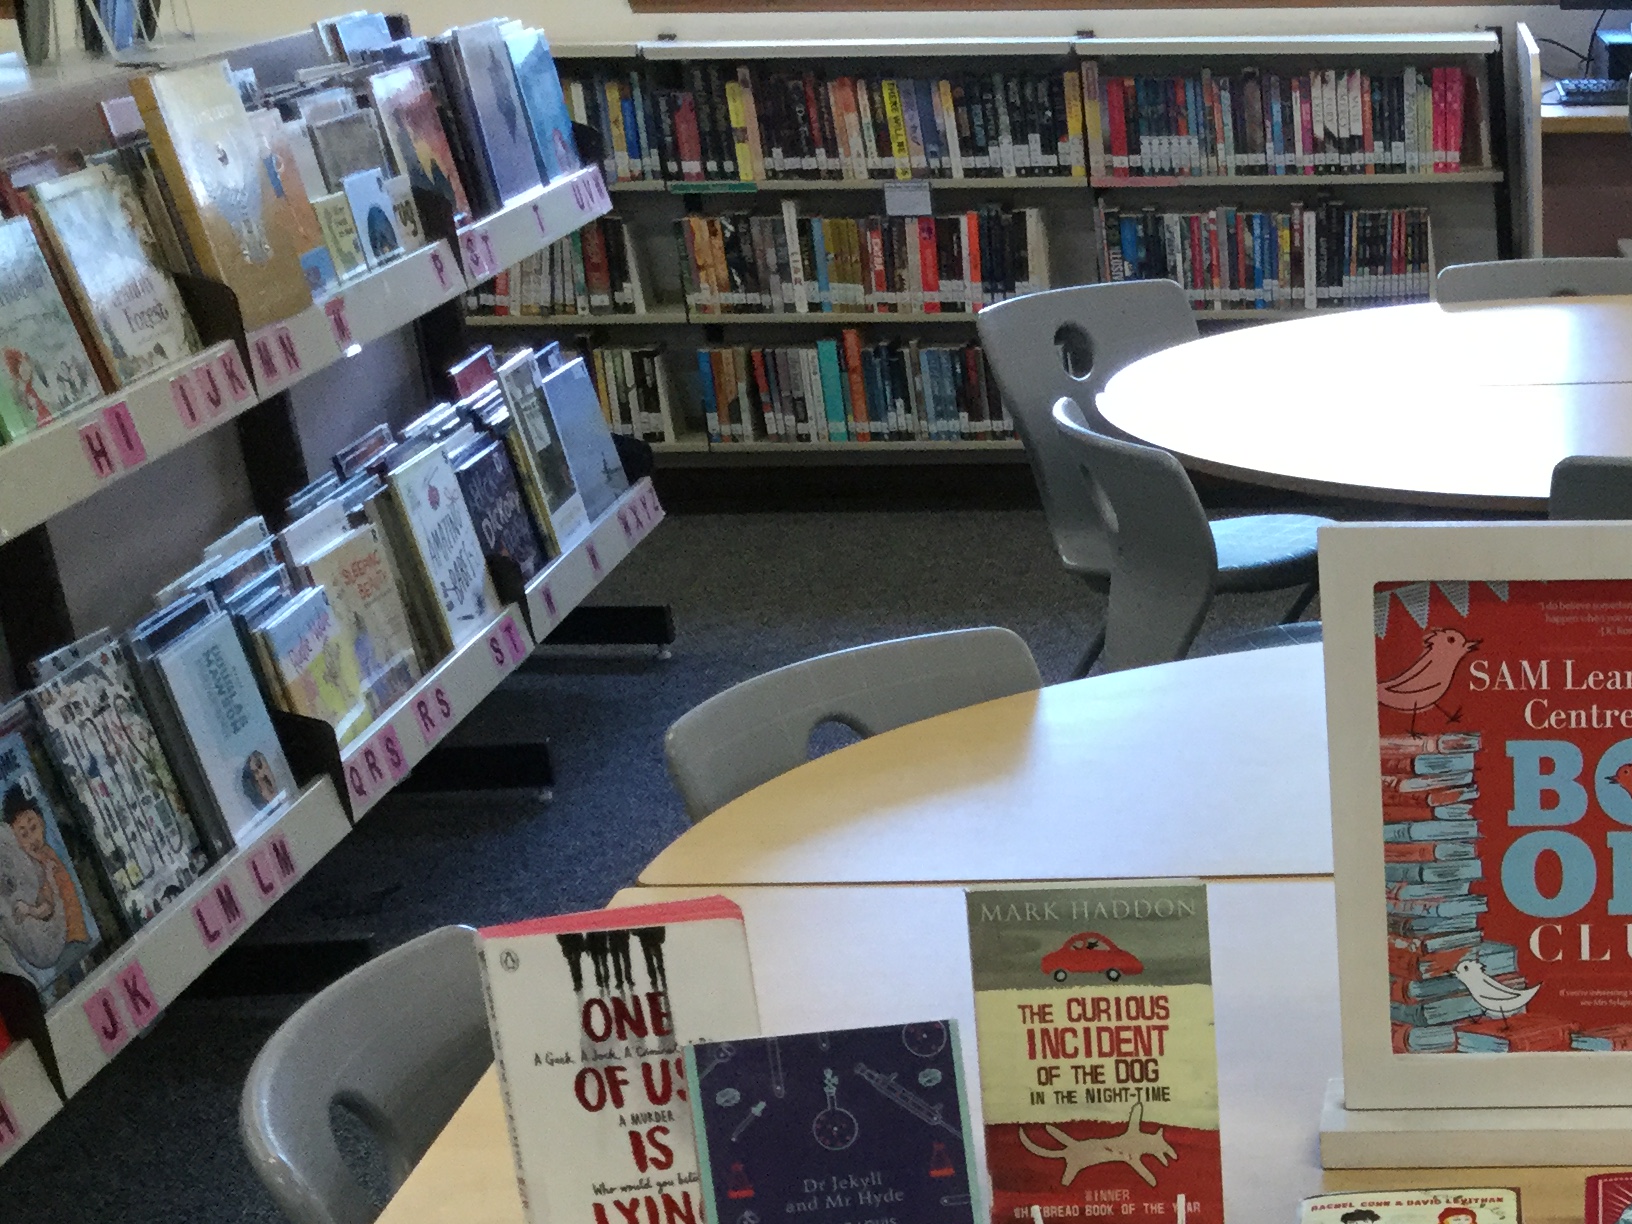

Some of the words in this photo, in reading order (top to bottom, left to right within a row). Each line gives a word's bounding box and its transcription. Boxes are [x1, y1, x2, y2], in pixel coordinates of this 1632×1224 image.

[205, 368, 221, 409] J
[222, 355, 246, 395] K
[85, 430, 113, 474] H
[490, 637, 505, 665] S
[1469, 660, 1550, 691] SAM
[418, 700, 435, 732] R
[437, 687, 451, 719] S
[364, 749, 384, 782] R
[385, 736, 403, 768] S
[252, 860, 274, 894] L
[196, 908, 220, 942] L
[980, 902, 1059, 923] MARK
[1071, 897, 1196, 921] HADDON
[102, 997, 118, 1040] J
[123, 974, 151, 1016] K
[582, 991, 673, 1043] ONE
[1017, 1003, 1053, 1025] THE
[1066, 995, 1170, 1024] CURIOUS
[1027, 1024, 1169, 1061] INCIDENT
[1037, 1066, 1060, 1087] OF
[1071, 1064, 1105, 1086] THE
[1115, 1058, 1159, 1085] DOG
[574, 1066, 629, 1113] OF
[1030, 1091, 1045, 1105] IN
[1053, 1090, 1078, 1105] THE
[1086, 1087, 1171, 1104] NIGHT-TIME
[619, 1114, 627, 1127] A
[631, 1110, 676, 1126] MURDER
[628, 1125, 674, 1173] IS
[803, 1176, 827, 1194] Dr
[831, 1171, 883, 1192] Jekyll
[1085, 1189, 1130, 1202] WINNER
[785, 1198, 819, 1215] and
[824, 1194, 853, 1212] Mr
[858, 1188, 905, 1210] Hyde
[1085, 1203, 1115, 1217] BOOK
[1121, 1202, 1136, 1215] OF
[1143, 1201, 1165, 1214] THE
[1172, 1200, 1201, 1214] YAR
